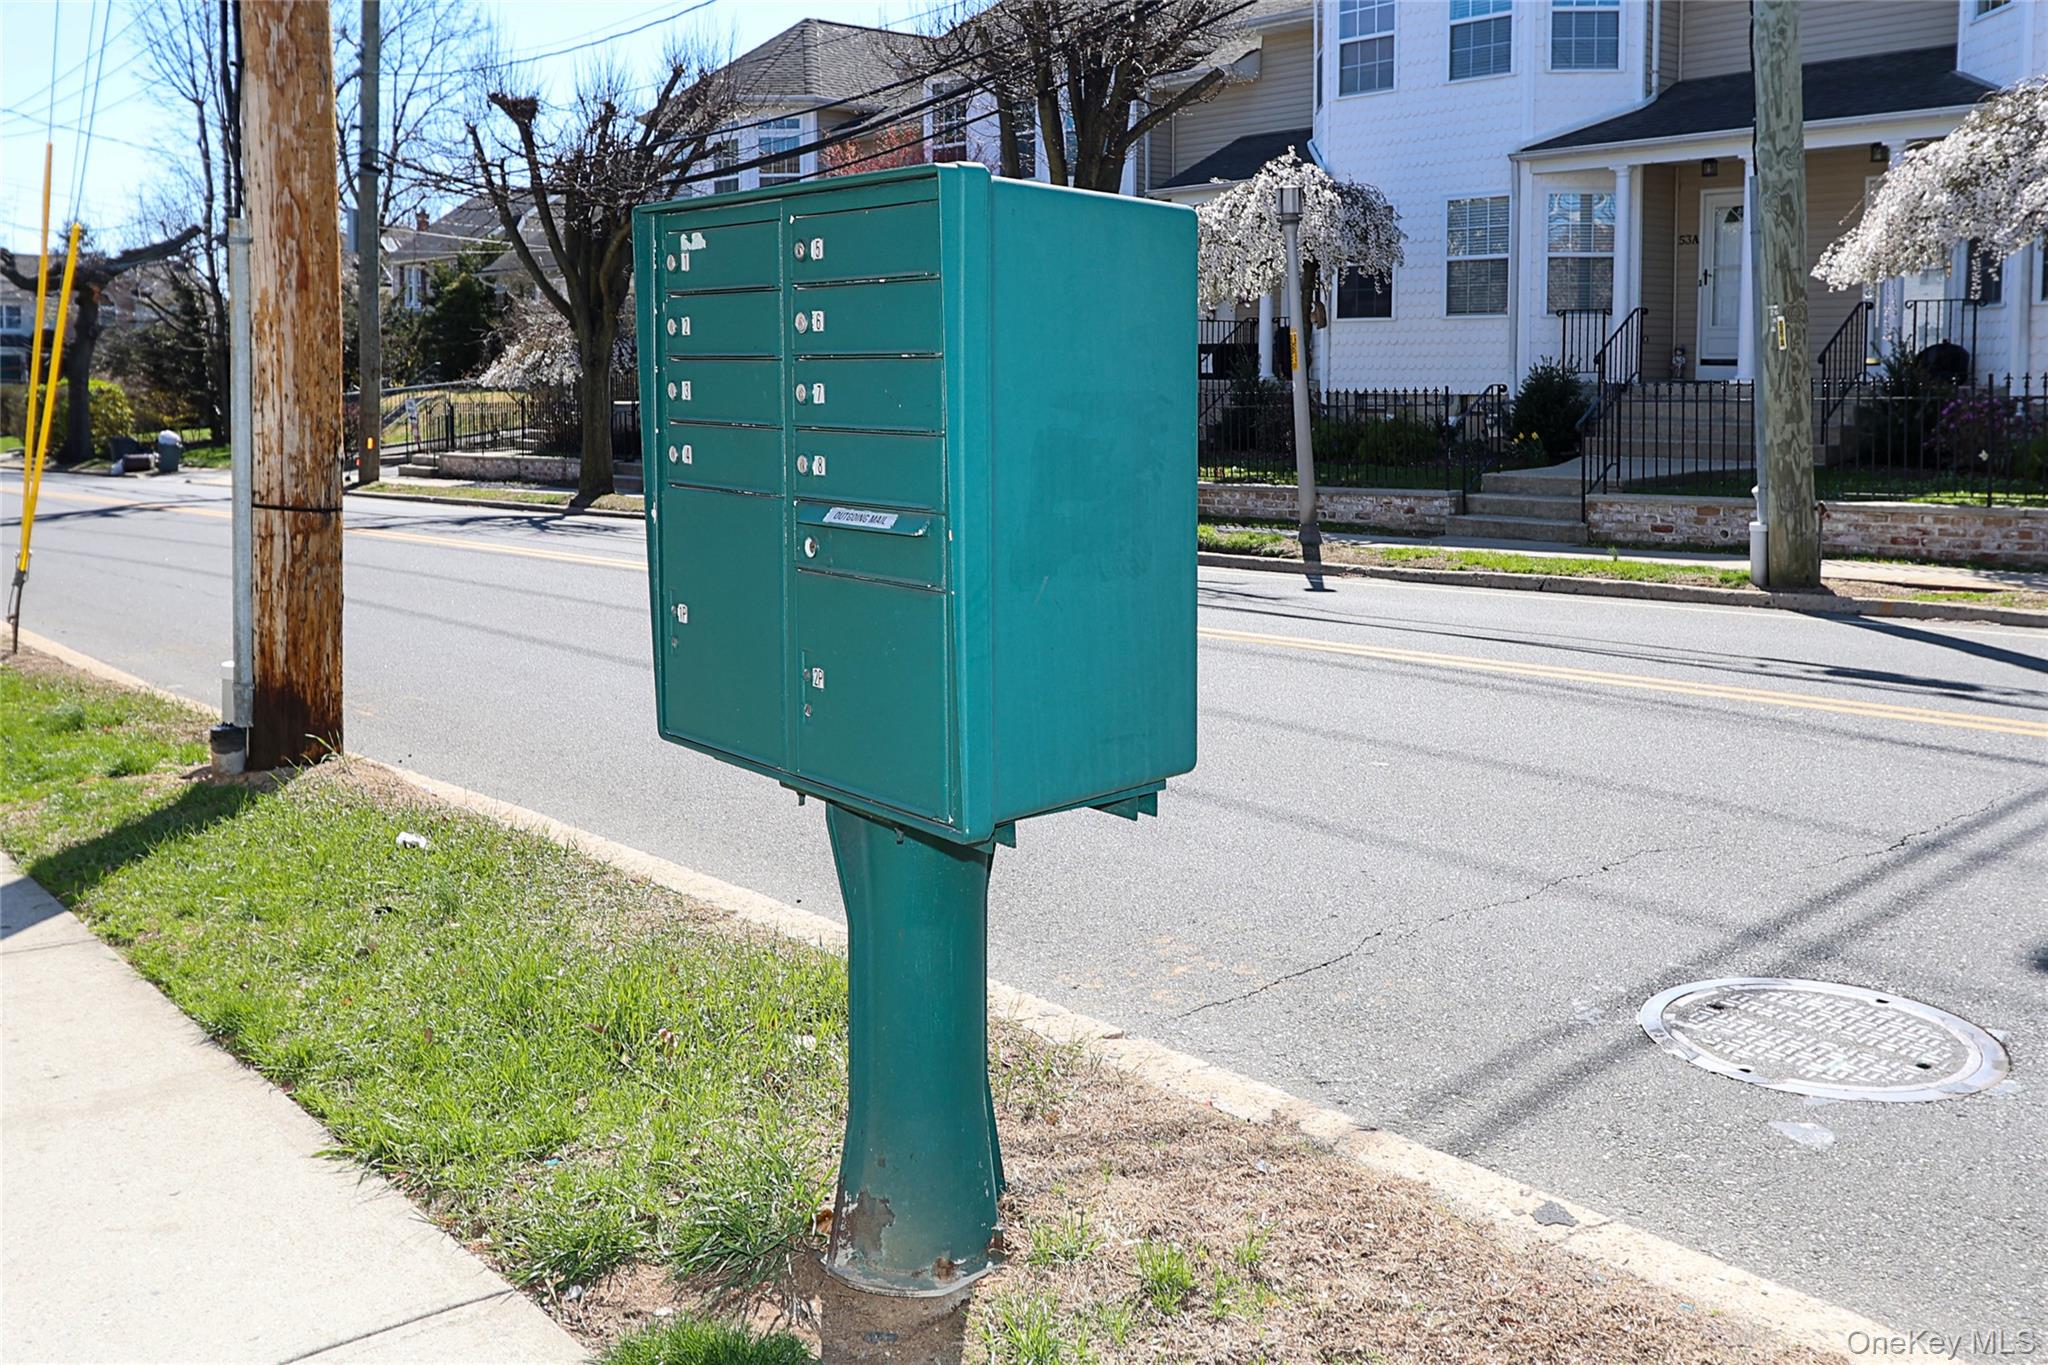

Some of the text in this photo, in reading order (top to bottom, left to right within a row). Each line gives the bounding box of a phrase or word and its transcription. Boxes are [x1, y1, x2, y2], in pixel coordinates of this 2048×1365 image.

[1679, 234, 1699, 245] 53A
[833, 511, 888, 525] OUTGOING MAIL
